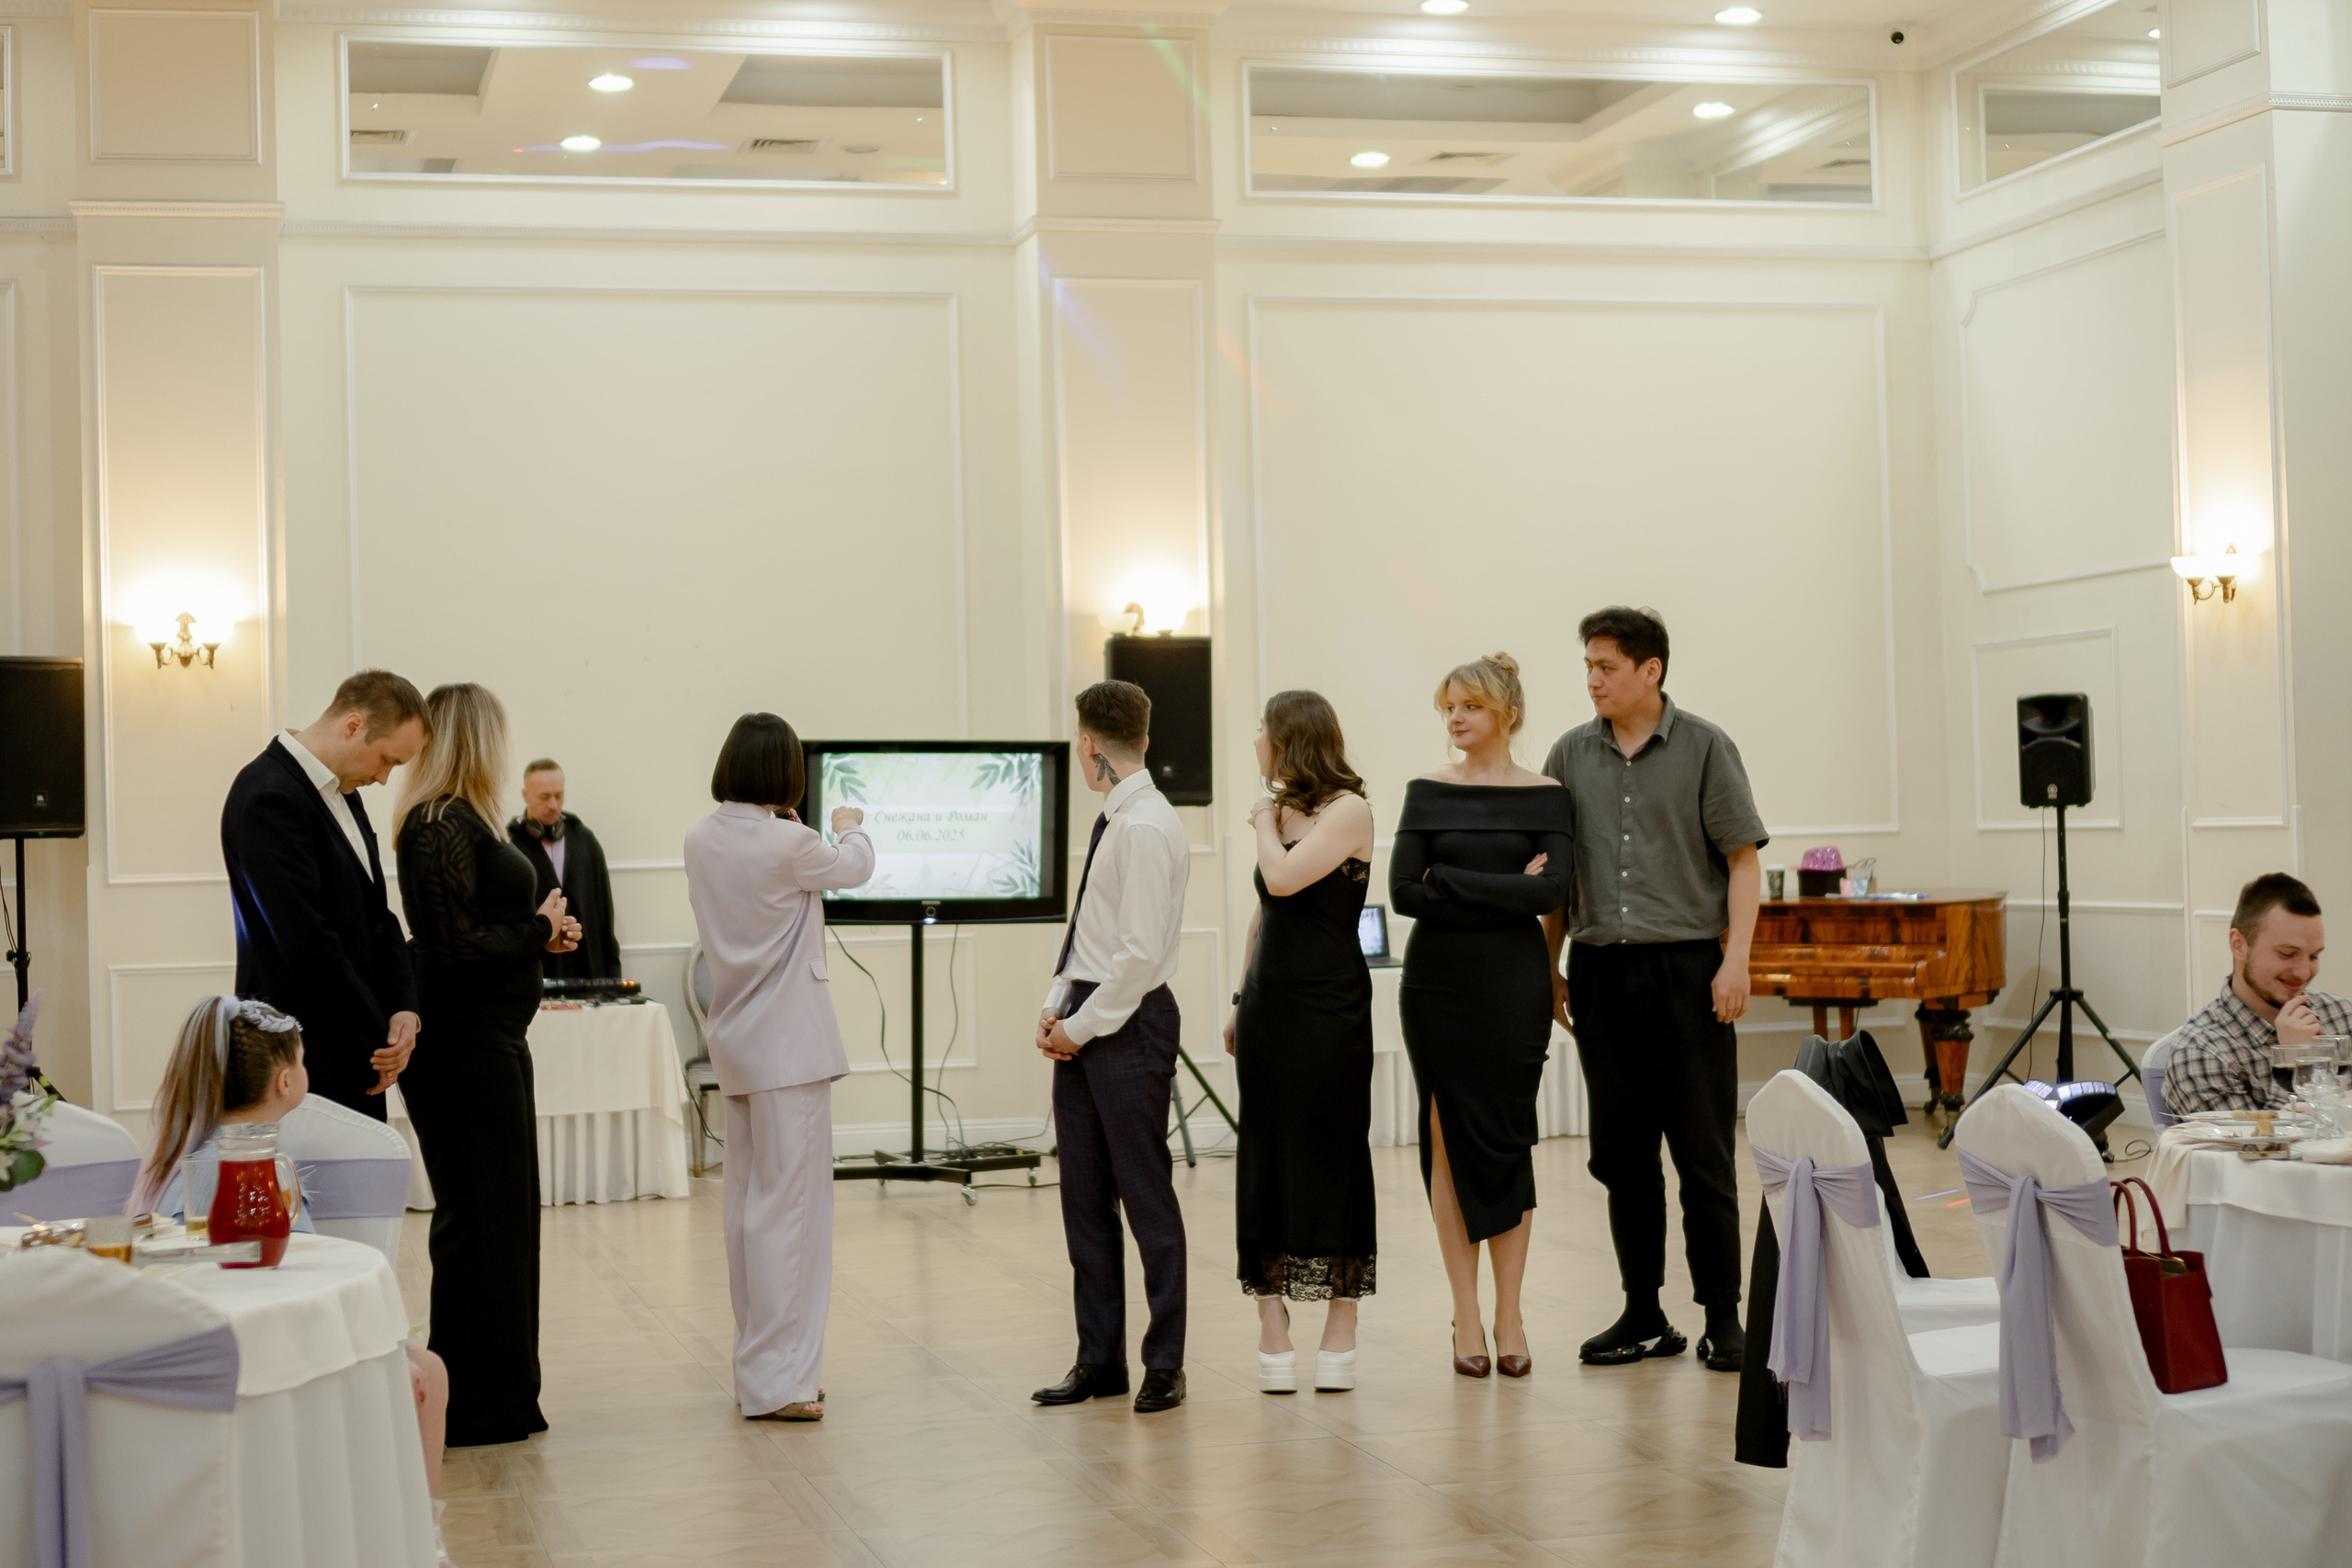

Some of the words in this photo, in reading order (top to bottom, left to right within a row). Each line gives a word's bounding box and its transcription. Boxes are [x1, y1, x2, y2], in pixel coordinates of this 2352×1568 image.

[875, 810, 930, 824] Снежана
[935, 812, 944, 822] и
[946, 810, 988, 822] Роман
[897, 829, 965, 840] 06.06.2025
